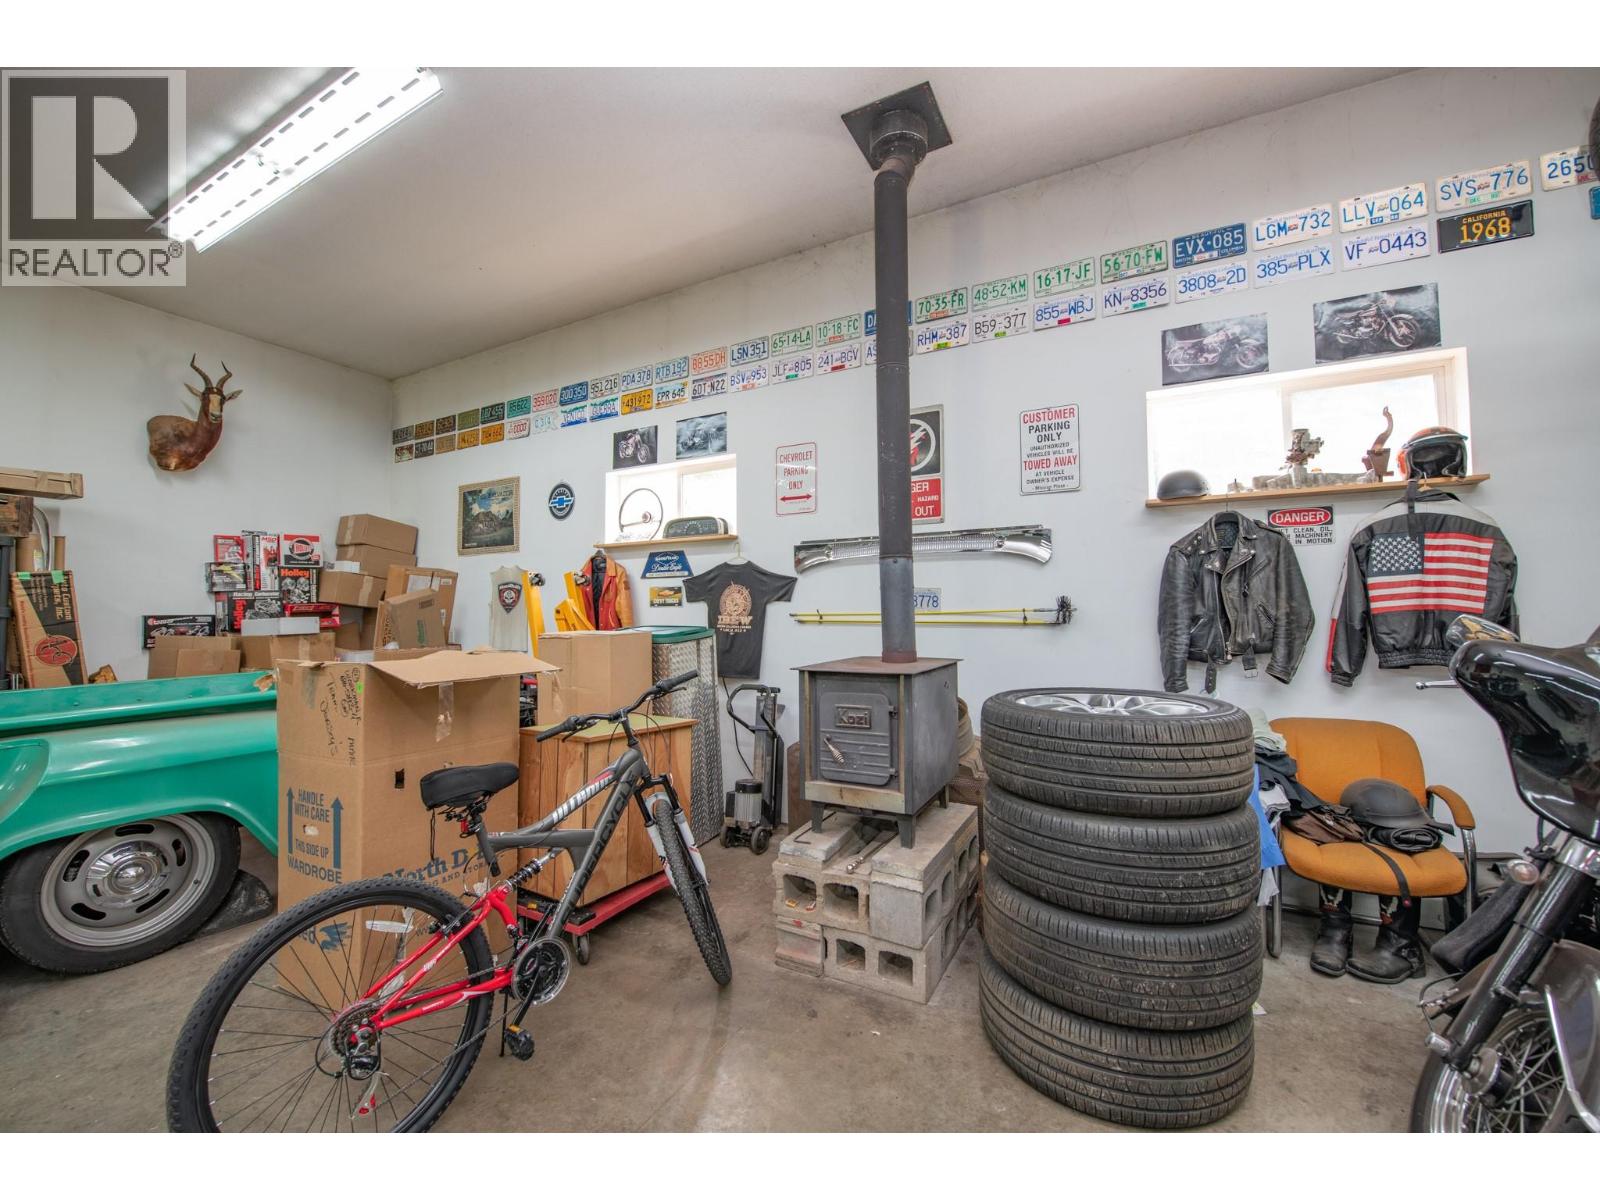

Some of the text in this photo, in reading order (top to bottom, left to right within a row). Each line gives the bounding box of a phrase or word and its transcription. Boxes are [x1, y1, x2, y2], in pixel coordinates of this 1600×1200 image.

[1440, 168, 1528, 201] SVS 776
[1343, 191, 1424, 223] LLV 064
[1256, 211, 1331, 241] LGM 732
[1462, 210, 1506, 224] CALIFORNIA
[1459, 217, 1511, 244] 1968
[1345, 231, 1427, 260] VF 0443
[1257, 250, 1331, 279] 385 PLX
[1178, 274, 1217, 294] 3808
[1105, 283, 1167, 309] KN 8356
[1035, 298, 1094, 321] 855 WBJ
[917, 325, 967, 347] RHM 387
[731, 341, 767, 361] LSN 351
[818, 355, 834, 369] 241
[840, 348, 858, 364] BGV
[751, 368, 767, 382] 953
[794, 359, 811, 373] 805
[1023, 407, 1075, 424] CUSTOMER
[1028, 420, 1070, 434] PARKING
[1029, 441, 1070, 451] UNAUTHORIZED
[1036, 431, 1062, 443] ONLY
[779, 450, 813, 464] CHEVROLET
[1023, 454, 1078, 471] TOWED AWAY
[1026, 450, 1051, 458] VEHICLES
[783, 465, 809, 477] PARKING
[788, 480, 804, 490] ONLY
[911, 481, 929, 493] GER
[914, 505, 935, 517] OUT
[1275, 511, 1325, 524] DANGER
[281, 568, 309, 578] Holley
[62, 593, 72, 620] Custom
[233, 599, 247, 629] Holley
[298, 788, 325, 807] HANDLE
[294, 802, 330, 823] WITH CARE
[295, 838, 329, 859] THIS SIDE UP
[287, 854, 343, 884] WARDROBE
